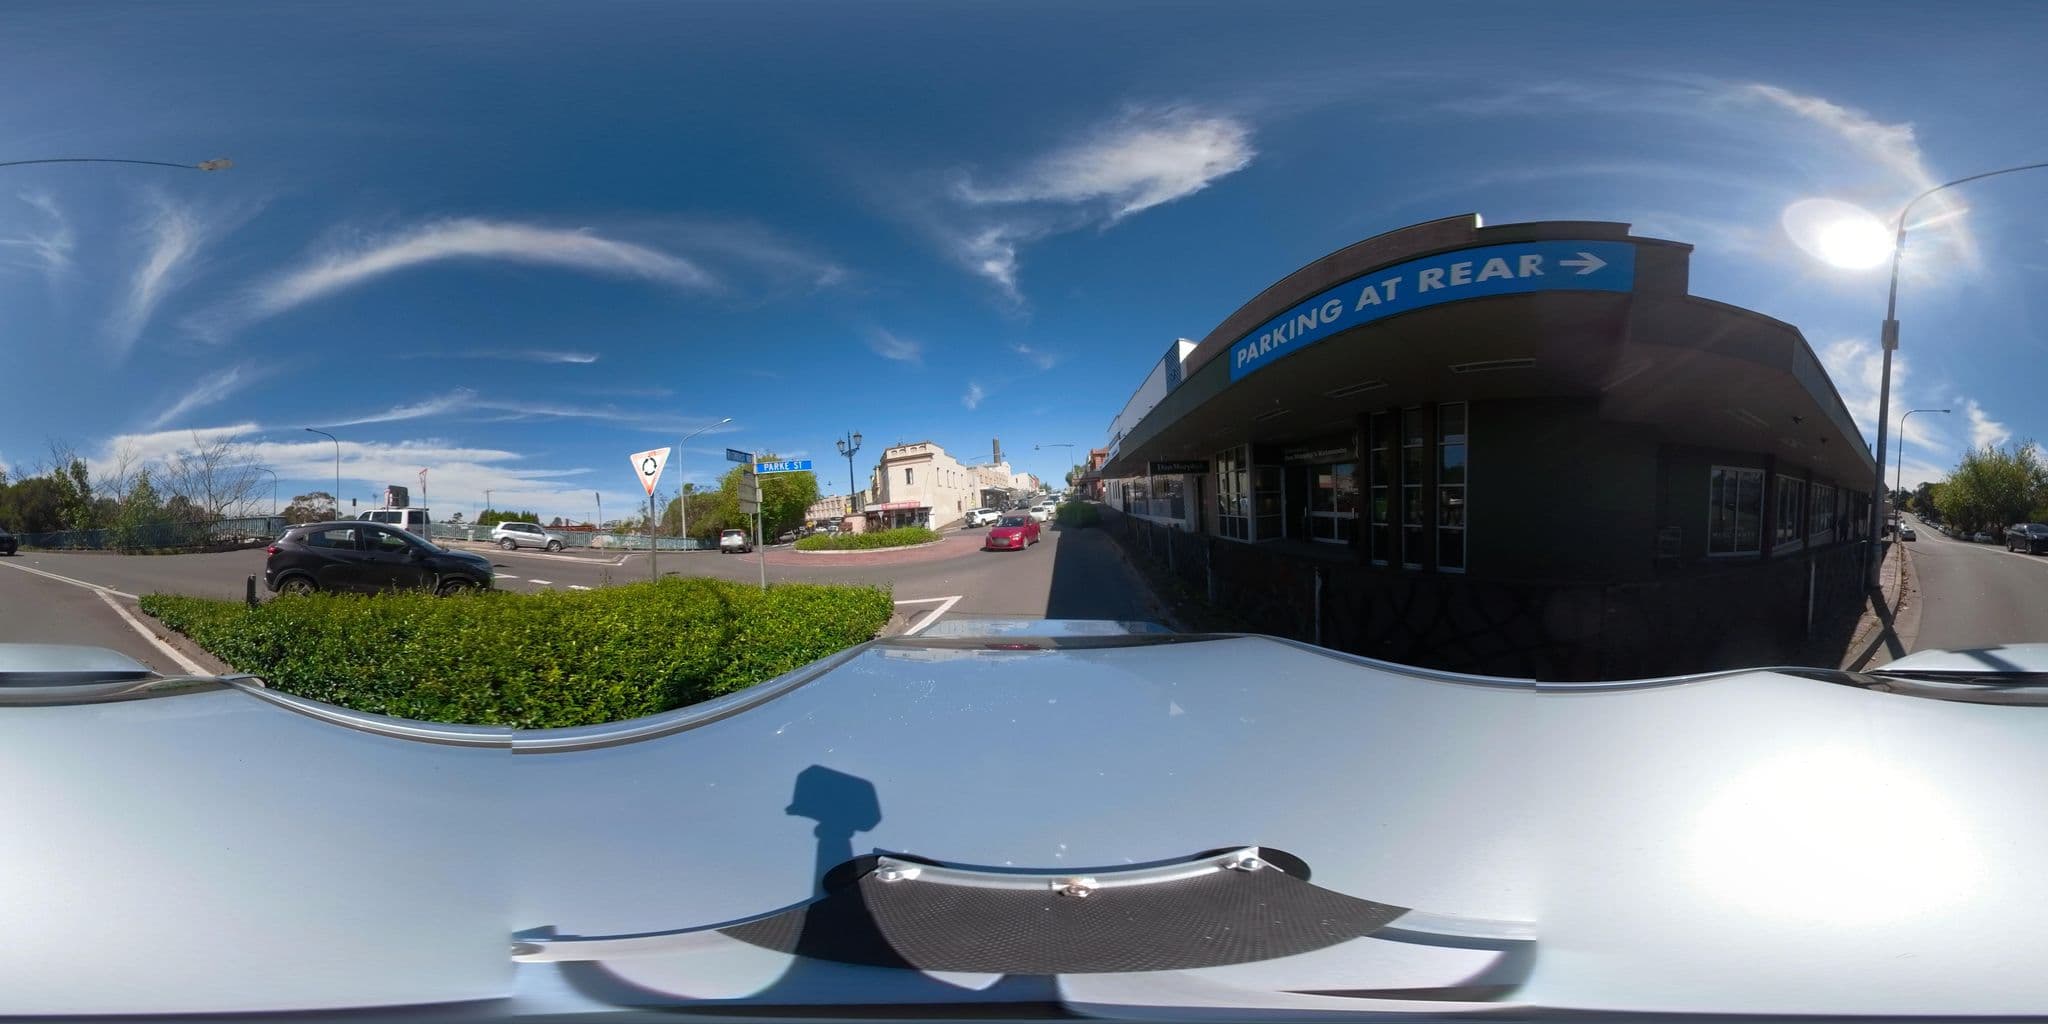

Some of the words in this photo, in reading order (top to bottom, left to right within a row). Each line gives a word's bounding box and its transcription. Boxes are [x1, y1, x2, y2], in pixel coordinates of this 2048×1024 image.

[1237, 298, 1344, 369] PARKING
[1355, 276, 1403, 312] AT
[1418, 253, 1545, 293] REAR
[763, 461, 790, 472] PARKE
[793, 460, 803, 470] ST
